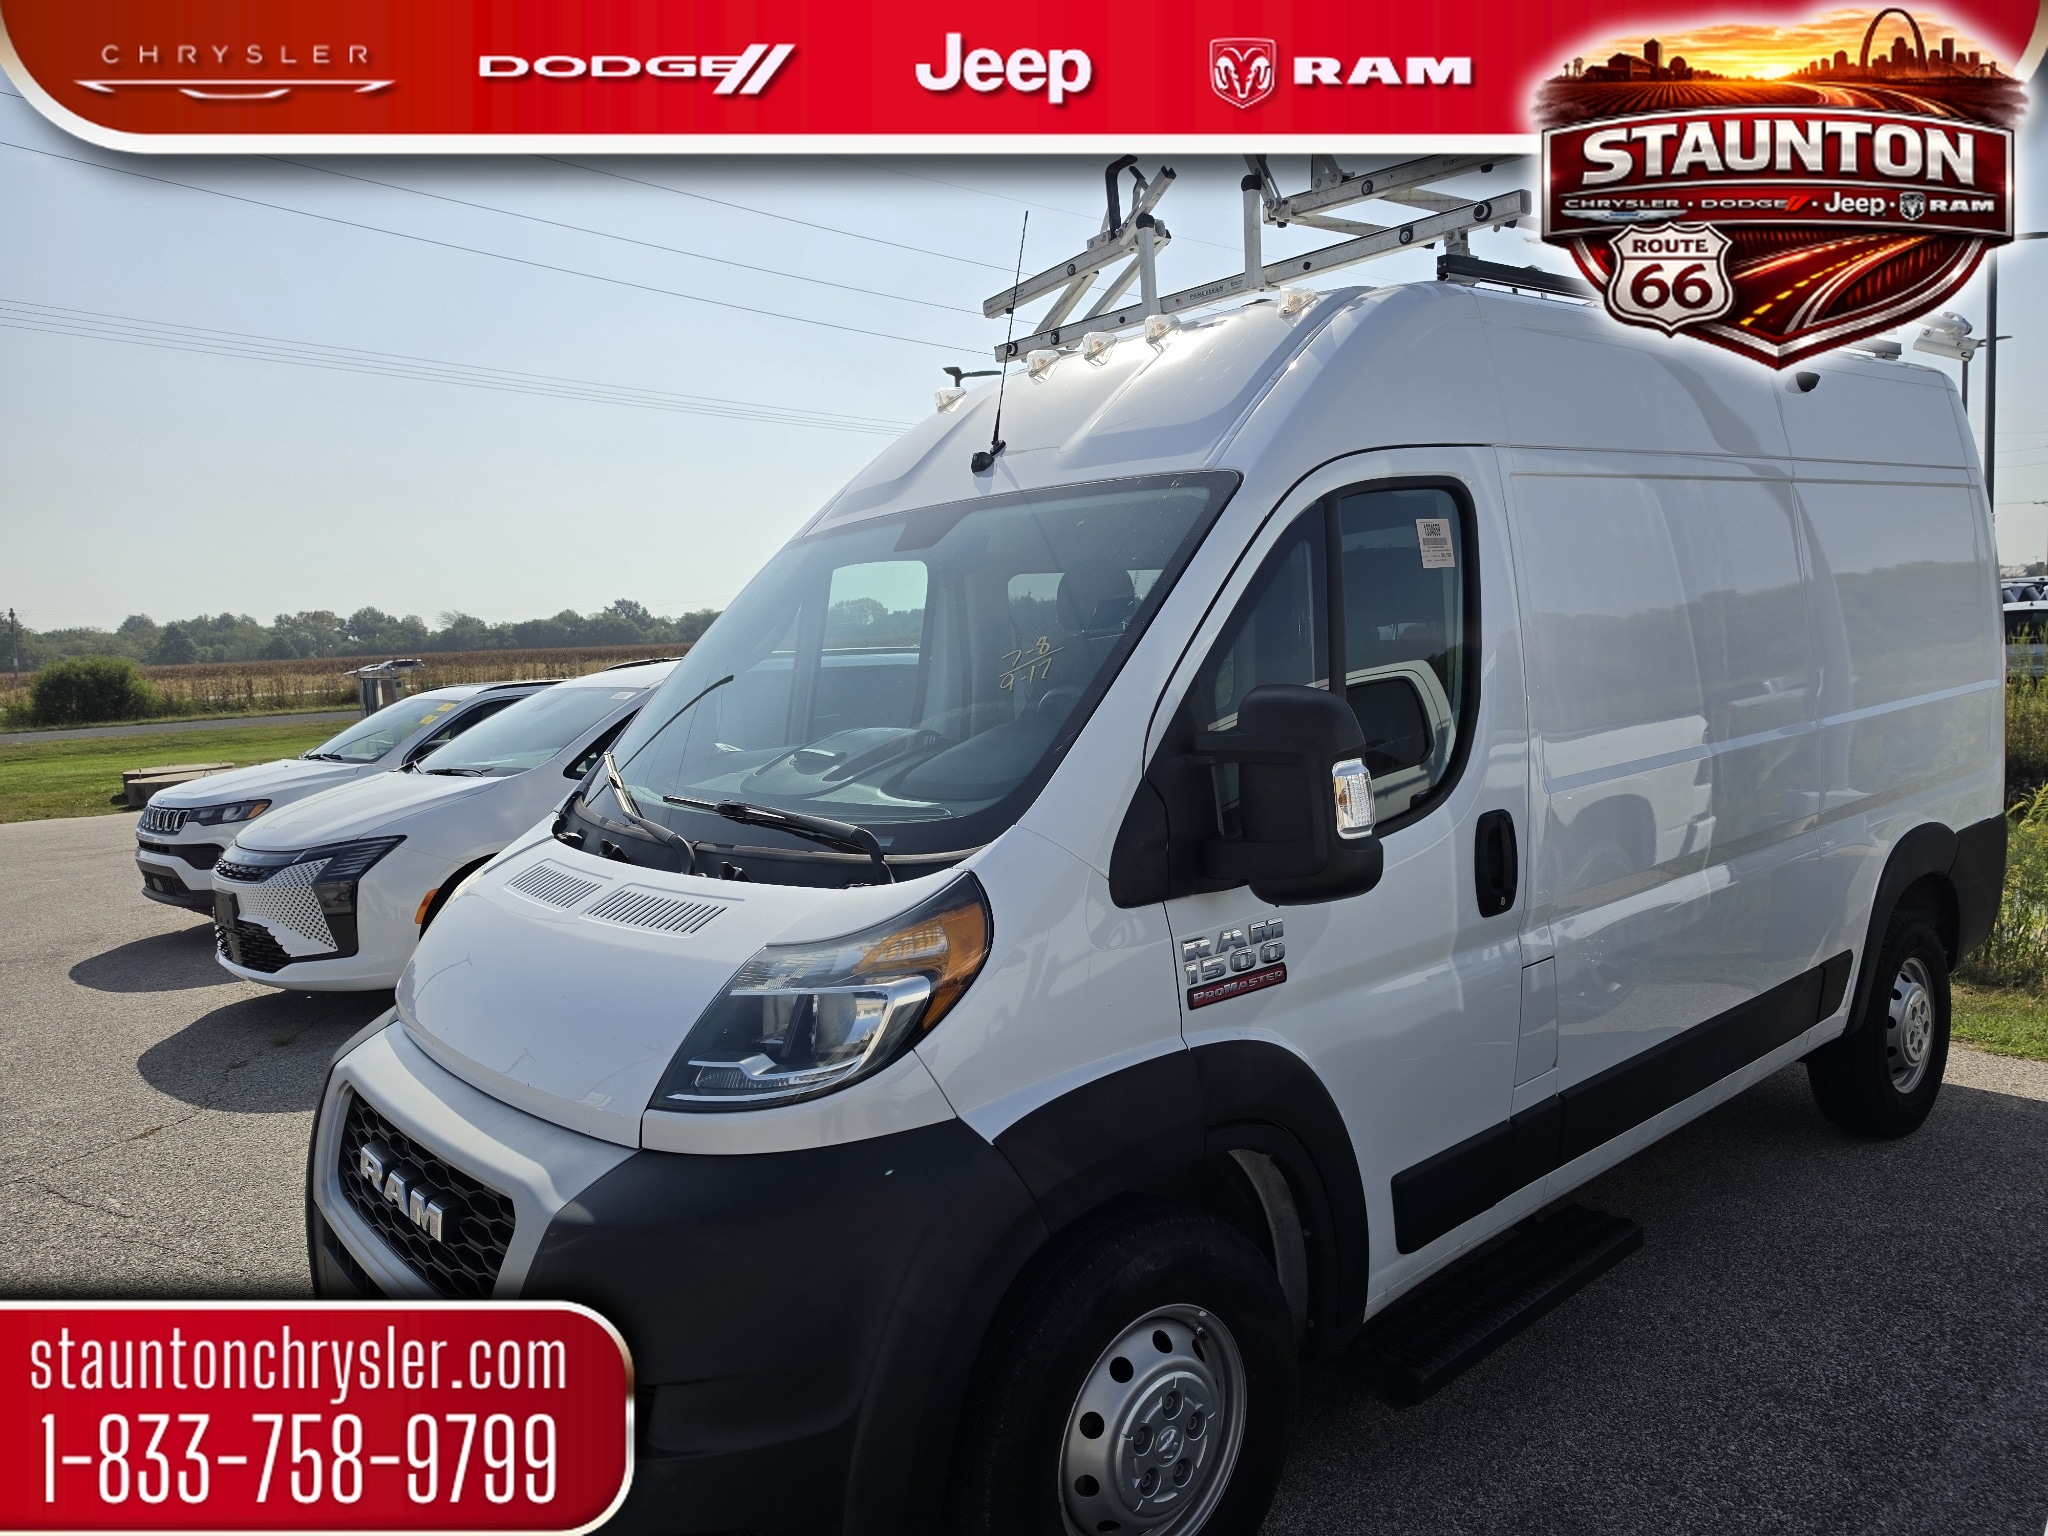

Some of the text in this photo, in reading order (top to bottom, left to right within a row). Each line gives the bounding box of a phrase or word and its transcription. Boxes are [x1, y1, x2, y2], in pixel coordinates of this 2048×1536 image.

[1001, 636, 1051, 667] 7-8
[1181, 917, 1284, 962] RAM
[1183, 941, 1286, 985] 1500
[360, 1144, 443, 1242] RAM
